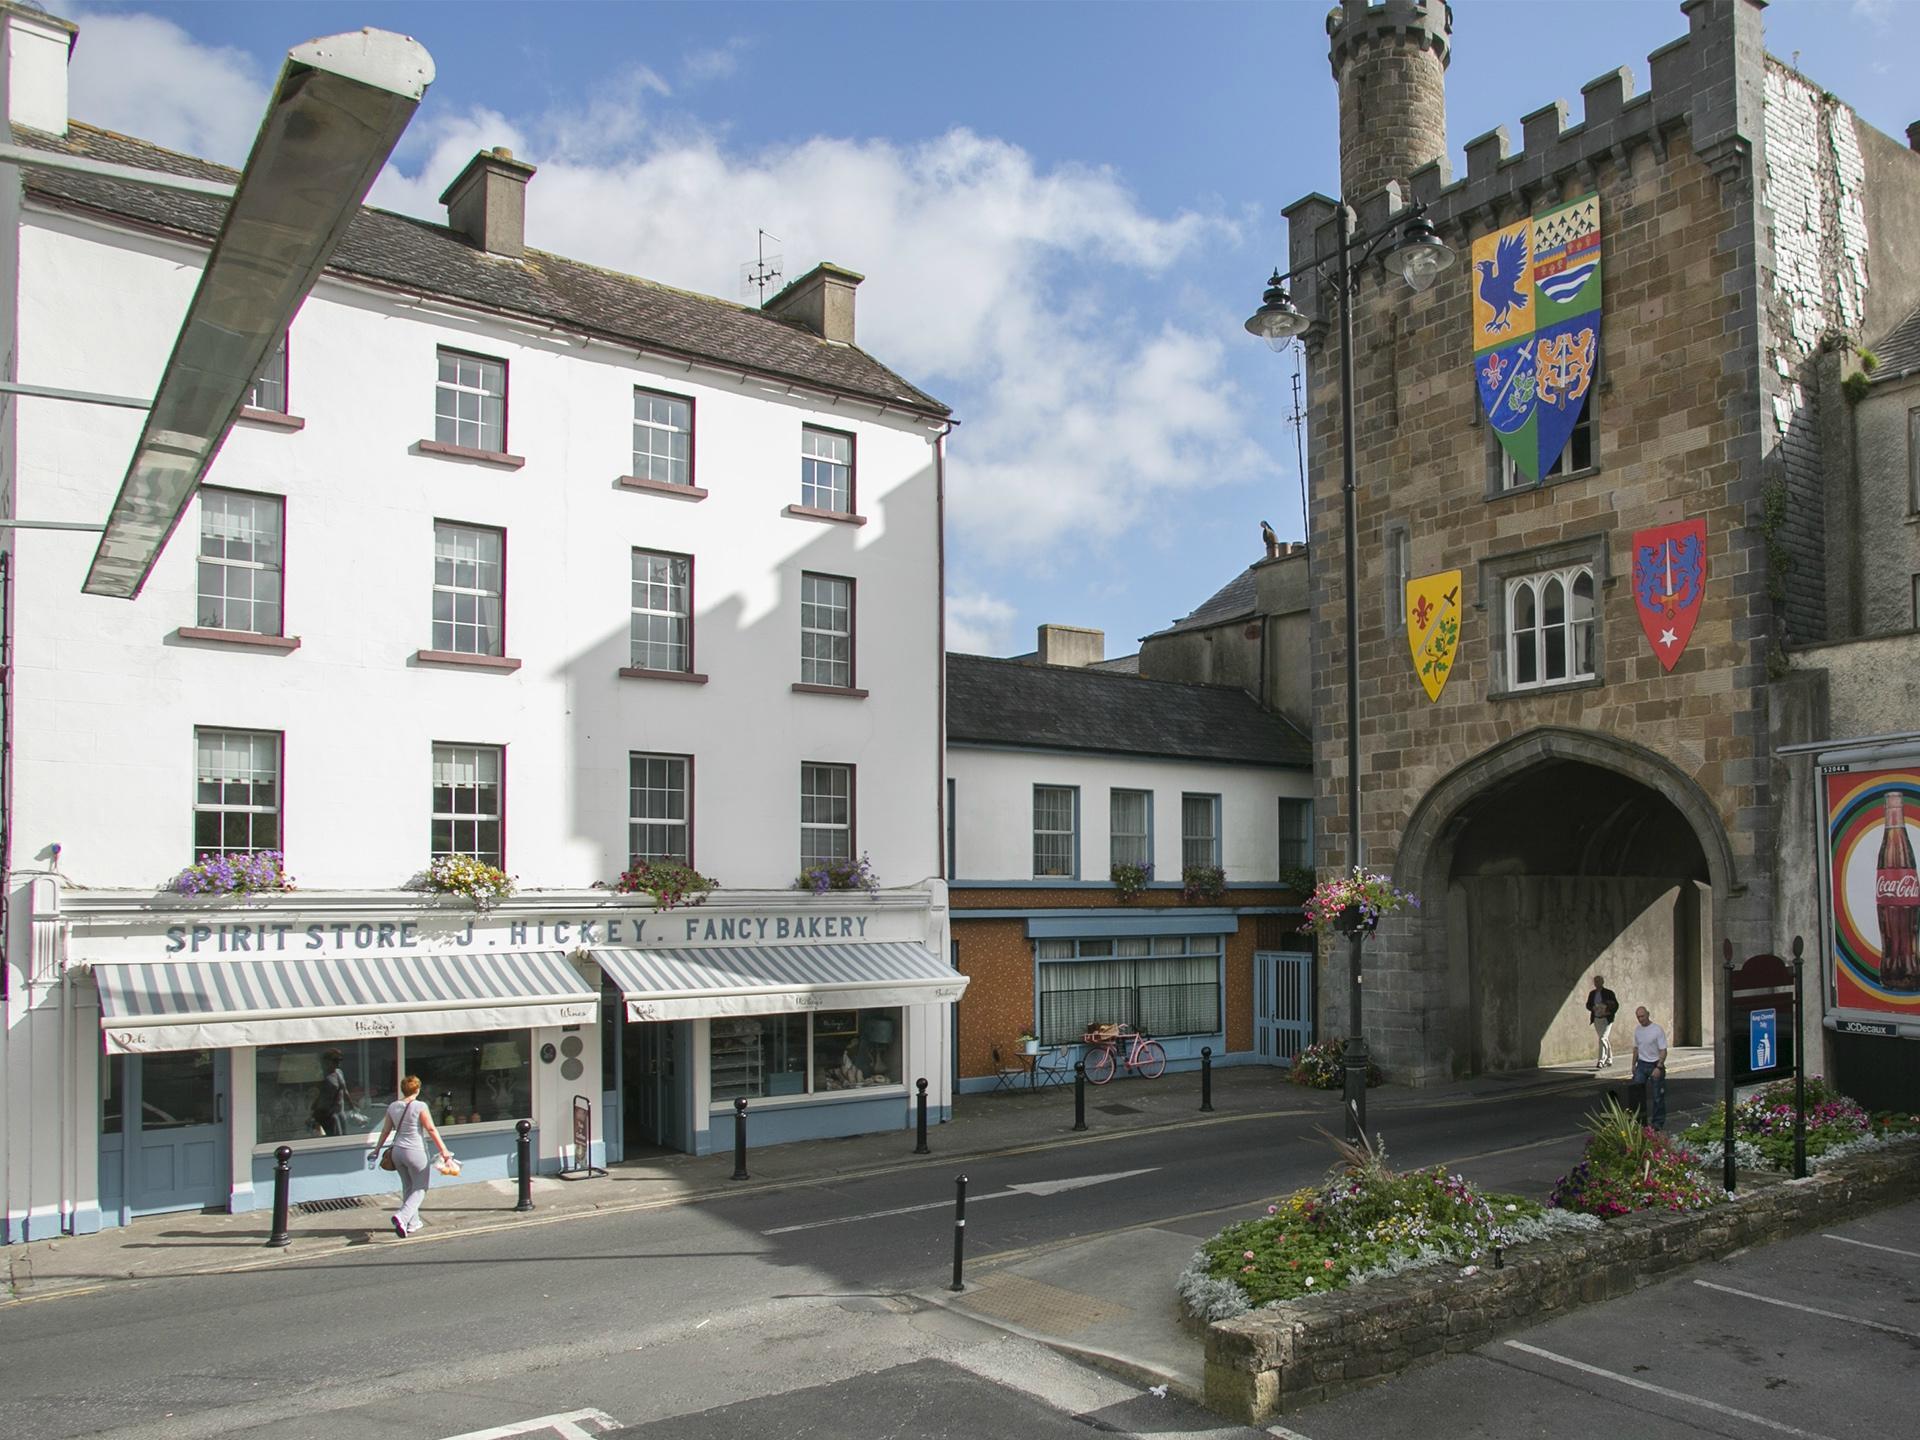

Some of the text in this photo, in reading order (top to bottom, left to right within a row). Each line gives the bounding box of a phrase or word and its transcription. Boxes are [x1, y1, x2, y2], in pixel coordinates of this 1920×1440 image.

[1876, 875, 1919, 898] Coca-Cola
[166, 924, 293, 952] SPIRIT
[306, 922, 418, 949] STORE
[686, 918, 768, 940] FANCY
[777, 916, 868, 938] BAKERY
[355, 1020, 395, 1036] Hickey's
[1846, 1022, 1887, 1034] JCDecaux
[119, 1032, 146, 1046] Deli
